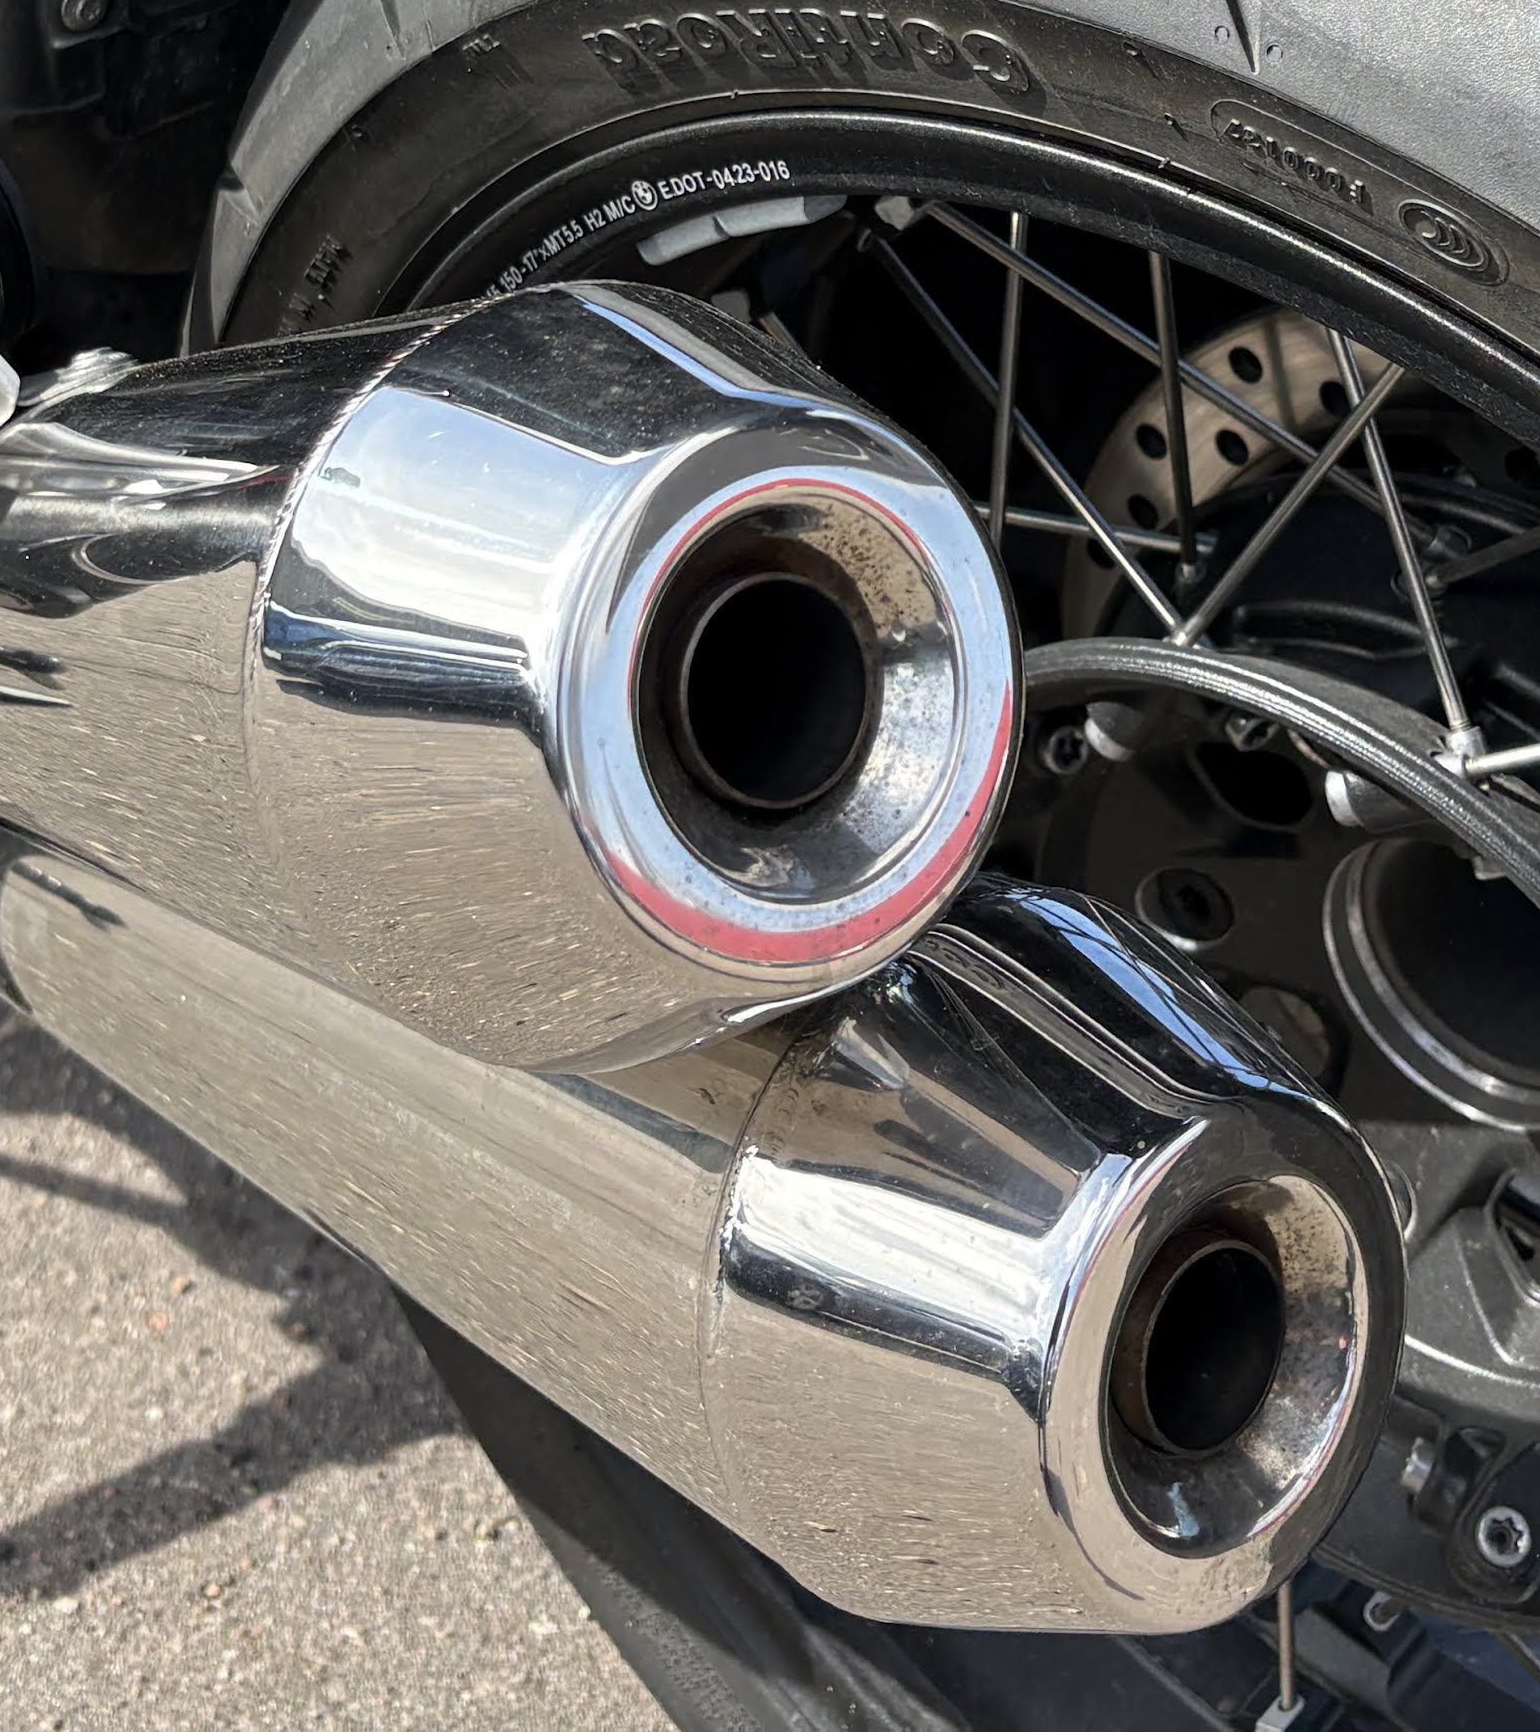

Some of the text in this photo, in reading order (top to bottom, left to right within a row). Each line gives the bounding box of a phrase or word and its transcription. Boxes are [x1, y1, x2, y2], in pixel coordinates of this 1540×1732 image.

[581, 8, 1033, 94] ContiRoad
[583, 208, 607, 232] H2
[602, 195, 636, 222] M/C
